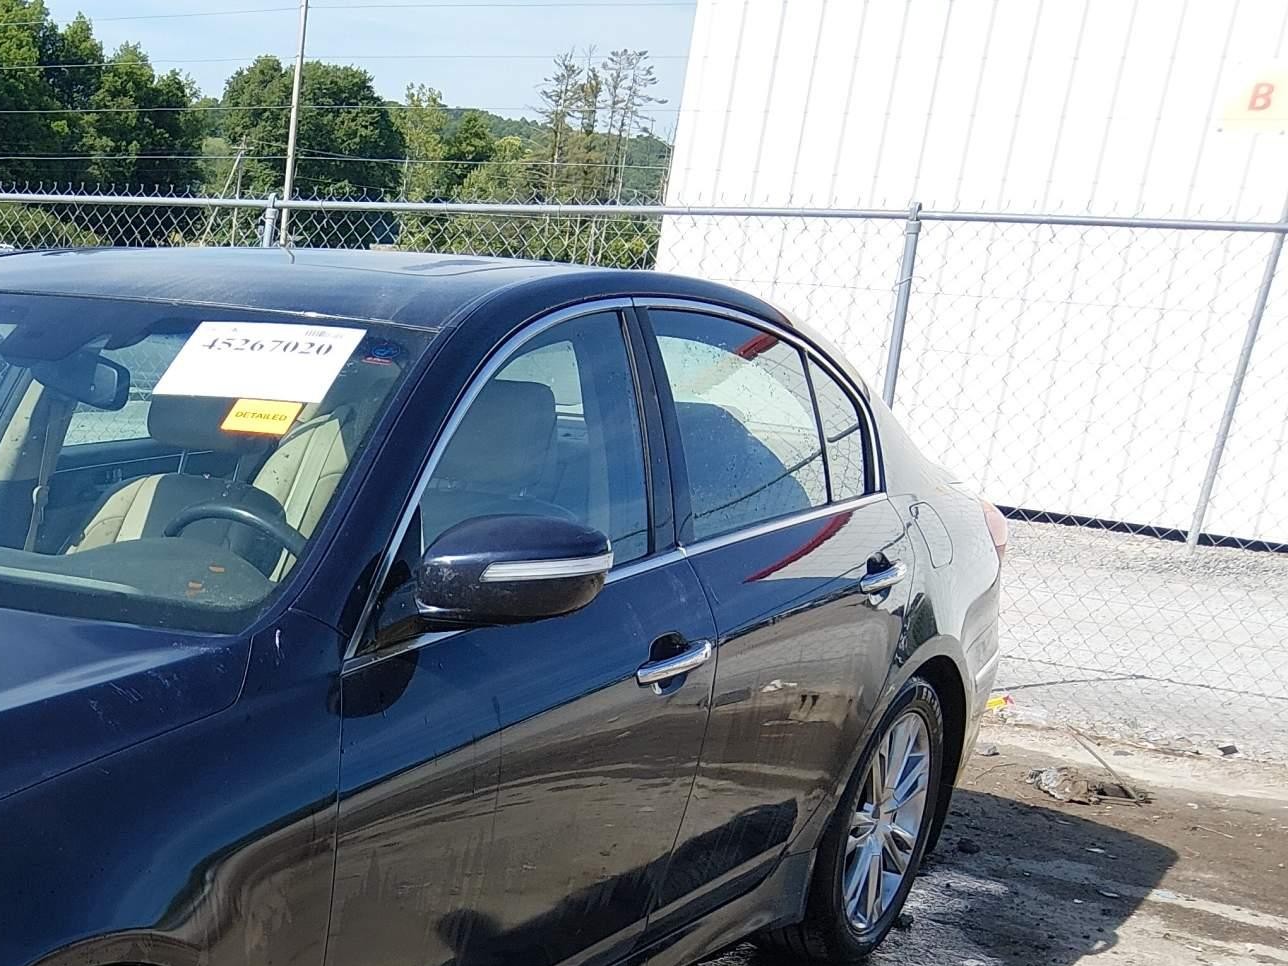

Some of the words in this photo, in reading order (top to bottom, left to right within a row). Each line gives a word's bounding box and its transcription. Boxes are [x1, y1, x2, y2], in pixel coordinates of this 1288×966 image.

[1248, 82, 1274, 111] B
[202, 338, 332, 355] 45267020
[234, 411, 288, 422] DETAILED
